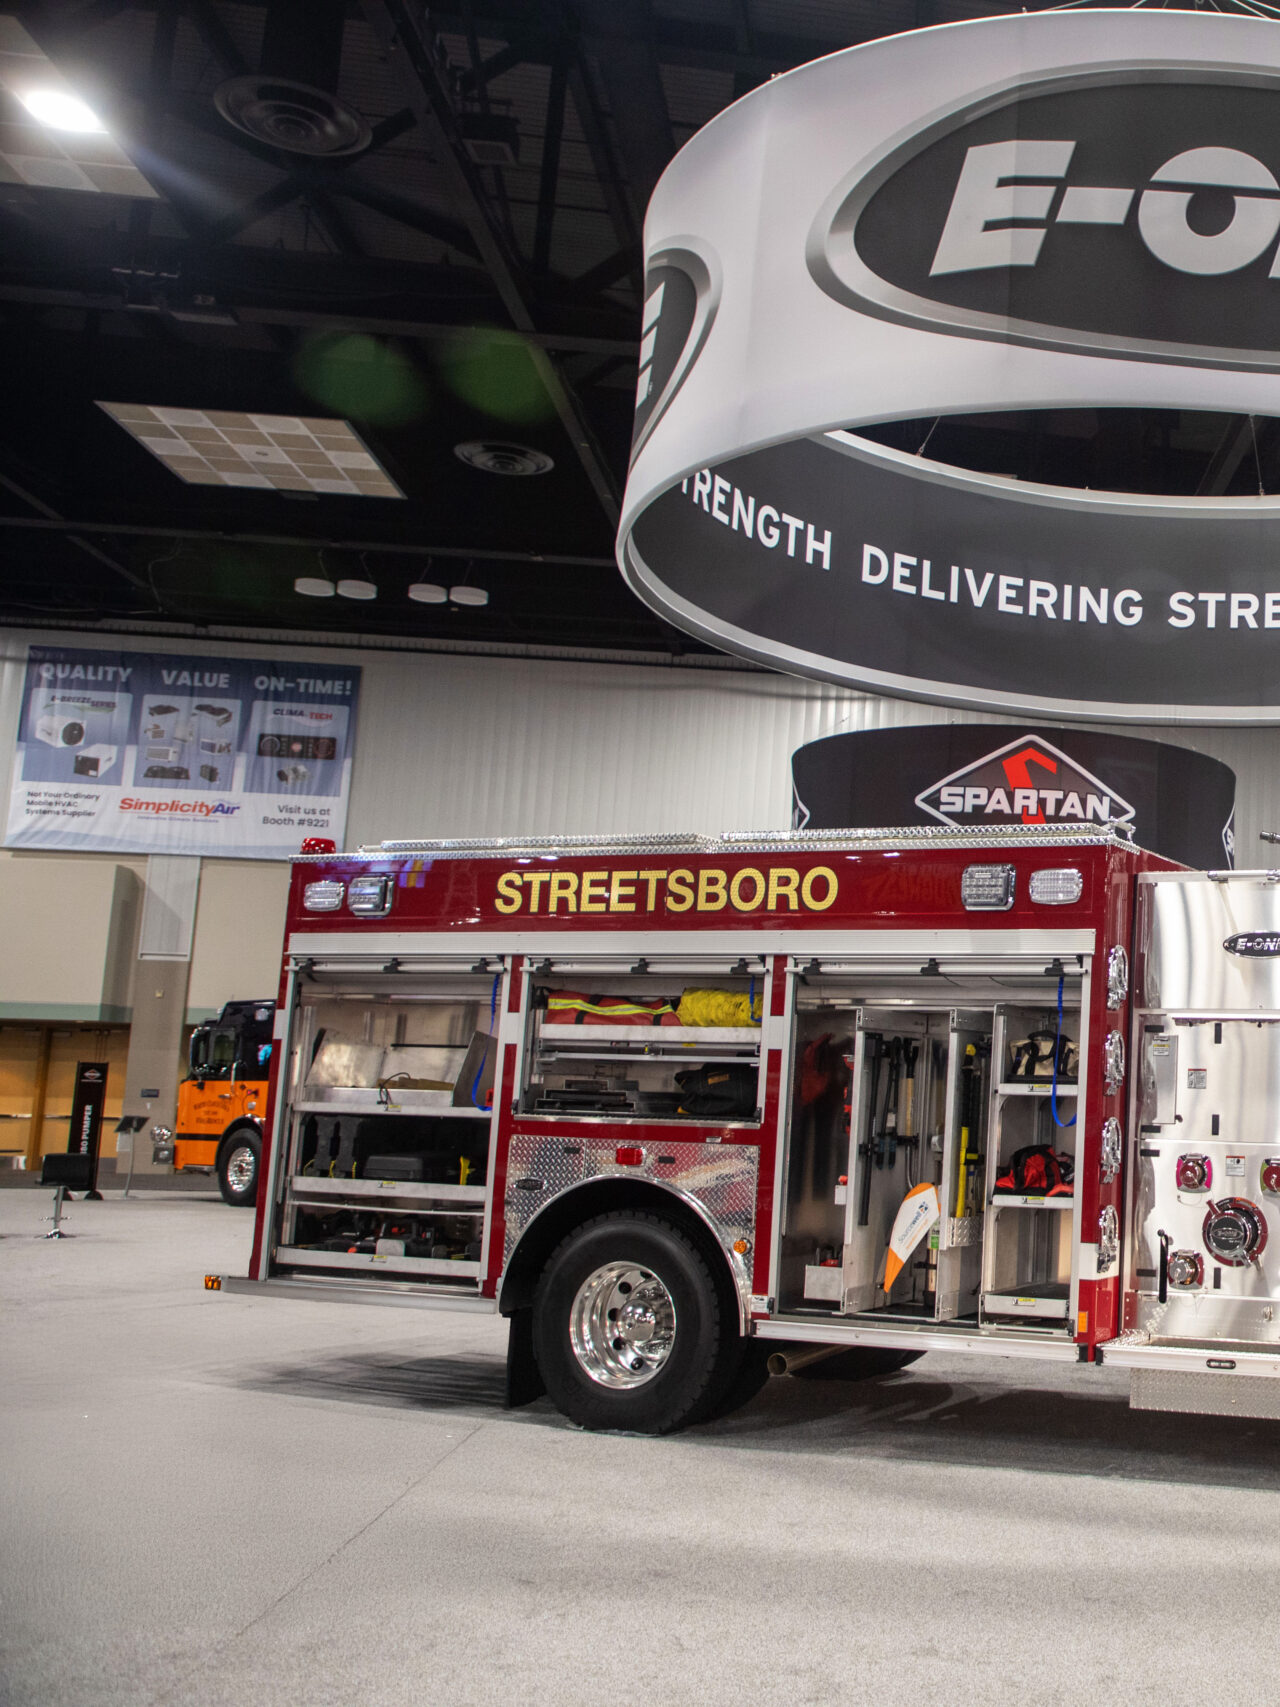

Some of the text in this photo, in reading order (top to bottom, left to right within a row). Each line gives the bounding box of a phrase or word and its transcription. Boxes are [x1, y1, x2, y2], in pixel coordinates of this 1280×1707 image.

[681, 468, 832, 571] RENGTH
[861, 543, 1144, 626] DELIVERING
[39, 662, 132, 683] QUALITY
[161, 669, 230, 688] VALUE
[254, 675, 352, 695] ON-TIME!
[63, 792, 100, 802] Ordinary
[939, 785, 1111, 822] SPARTAN
[25, 808, 96, 818] Systems Supplier
[278, 805, 331, 816] Visit us at
[262, 816, 329, 828] Booth #9221
[493, 866, 839, 914] STREETSBORO
[81, 1104, 93, 1140] PUMPER
